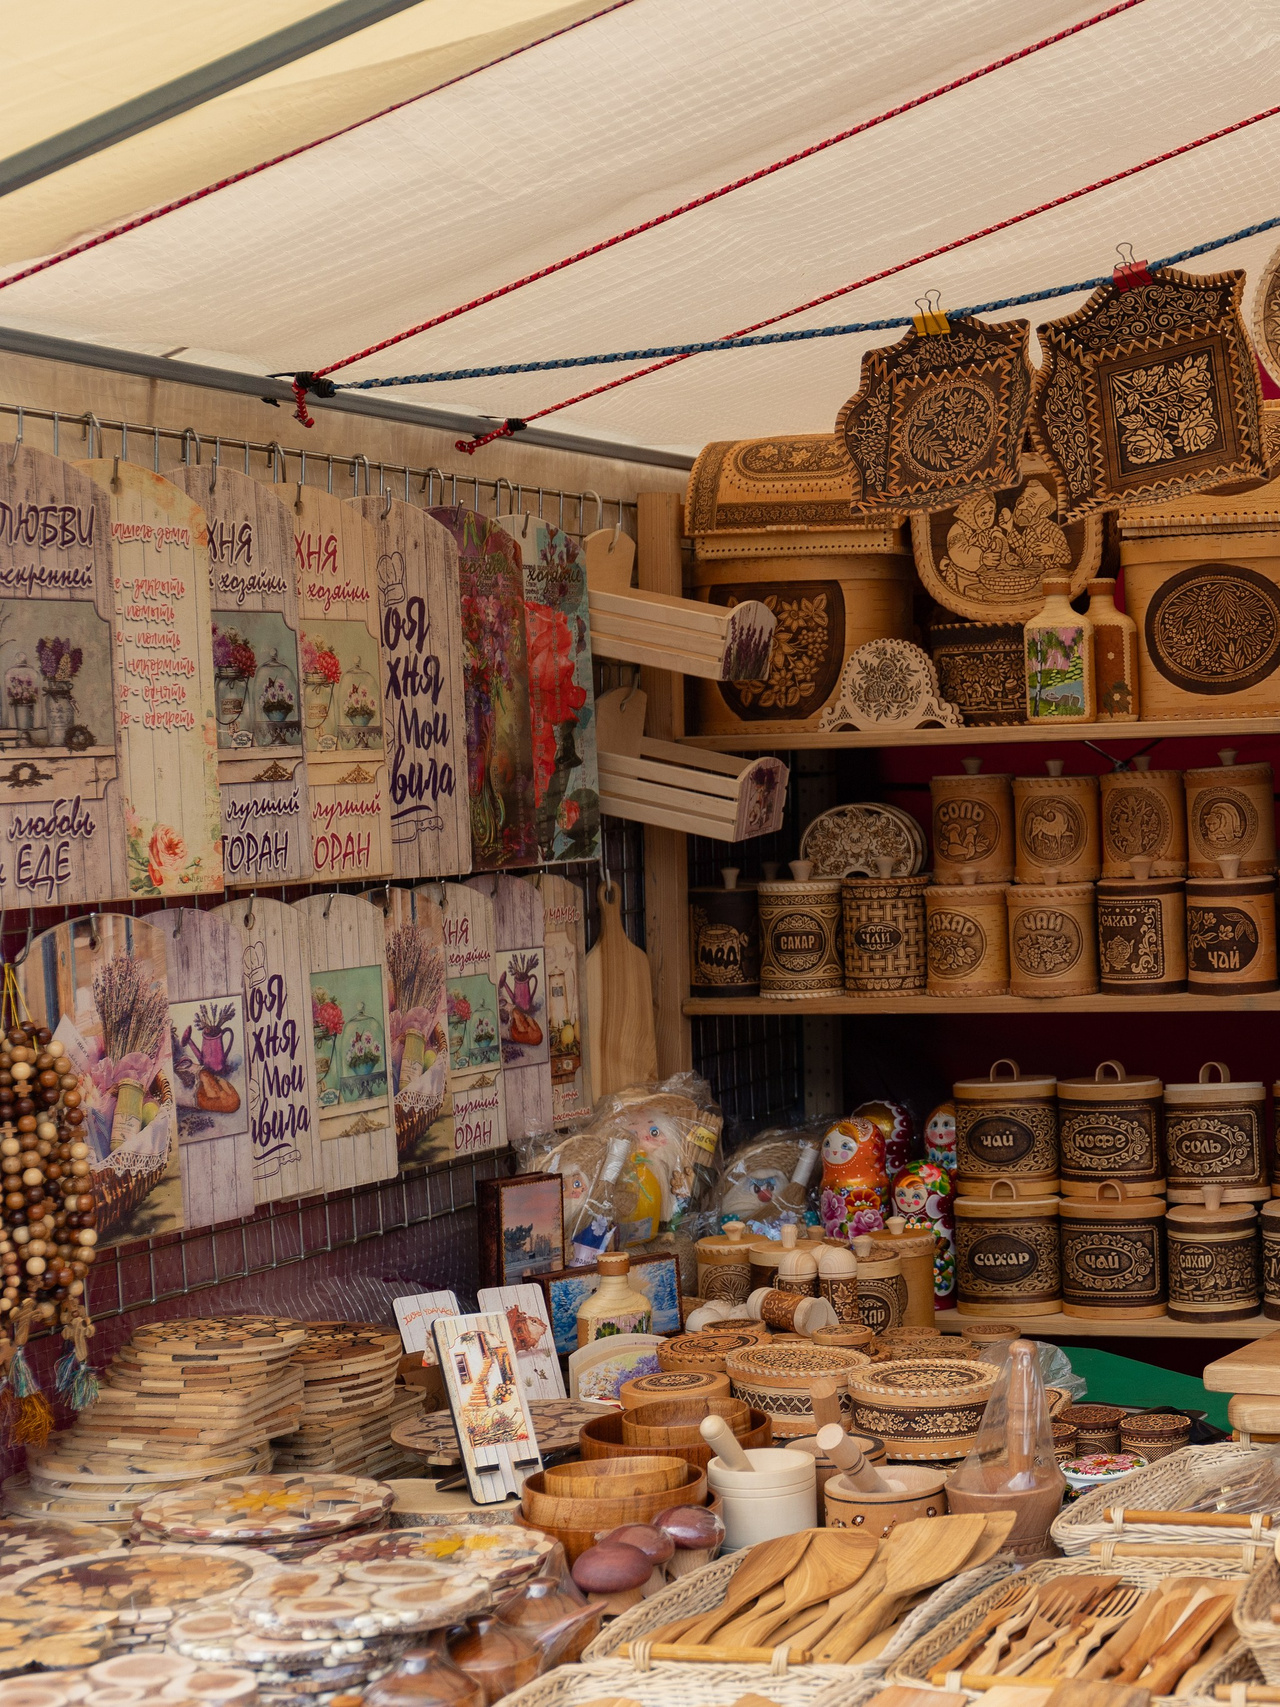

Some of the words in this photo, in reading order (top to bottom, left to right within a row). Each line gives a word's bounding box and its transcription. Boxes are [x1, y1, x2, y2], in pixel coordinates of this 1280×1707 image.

[157, 527, 190, 549] дома
[207, 518, 253, 564] ХНЯ
[294, 530, 339, 574] ХНЯ
[0, 562, 92, 597] скренней
[9, 795, 96, 839] любовь
[227, 788, 300, 831] лучший
[313, 793, 381, 831] лучший
[18, 841, 71, 899] ЕДЕ
[313, 831, 371, 872] ОРАН
[780, 935, 815, 950] САХАР
[455, 1120, 492, 1150] ОРАН
[859, 1309, 885, 1325] ХАР
